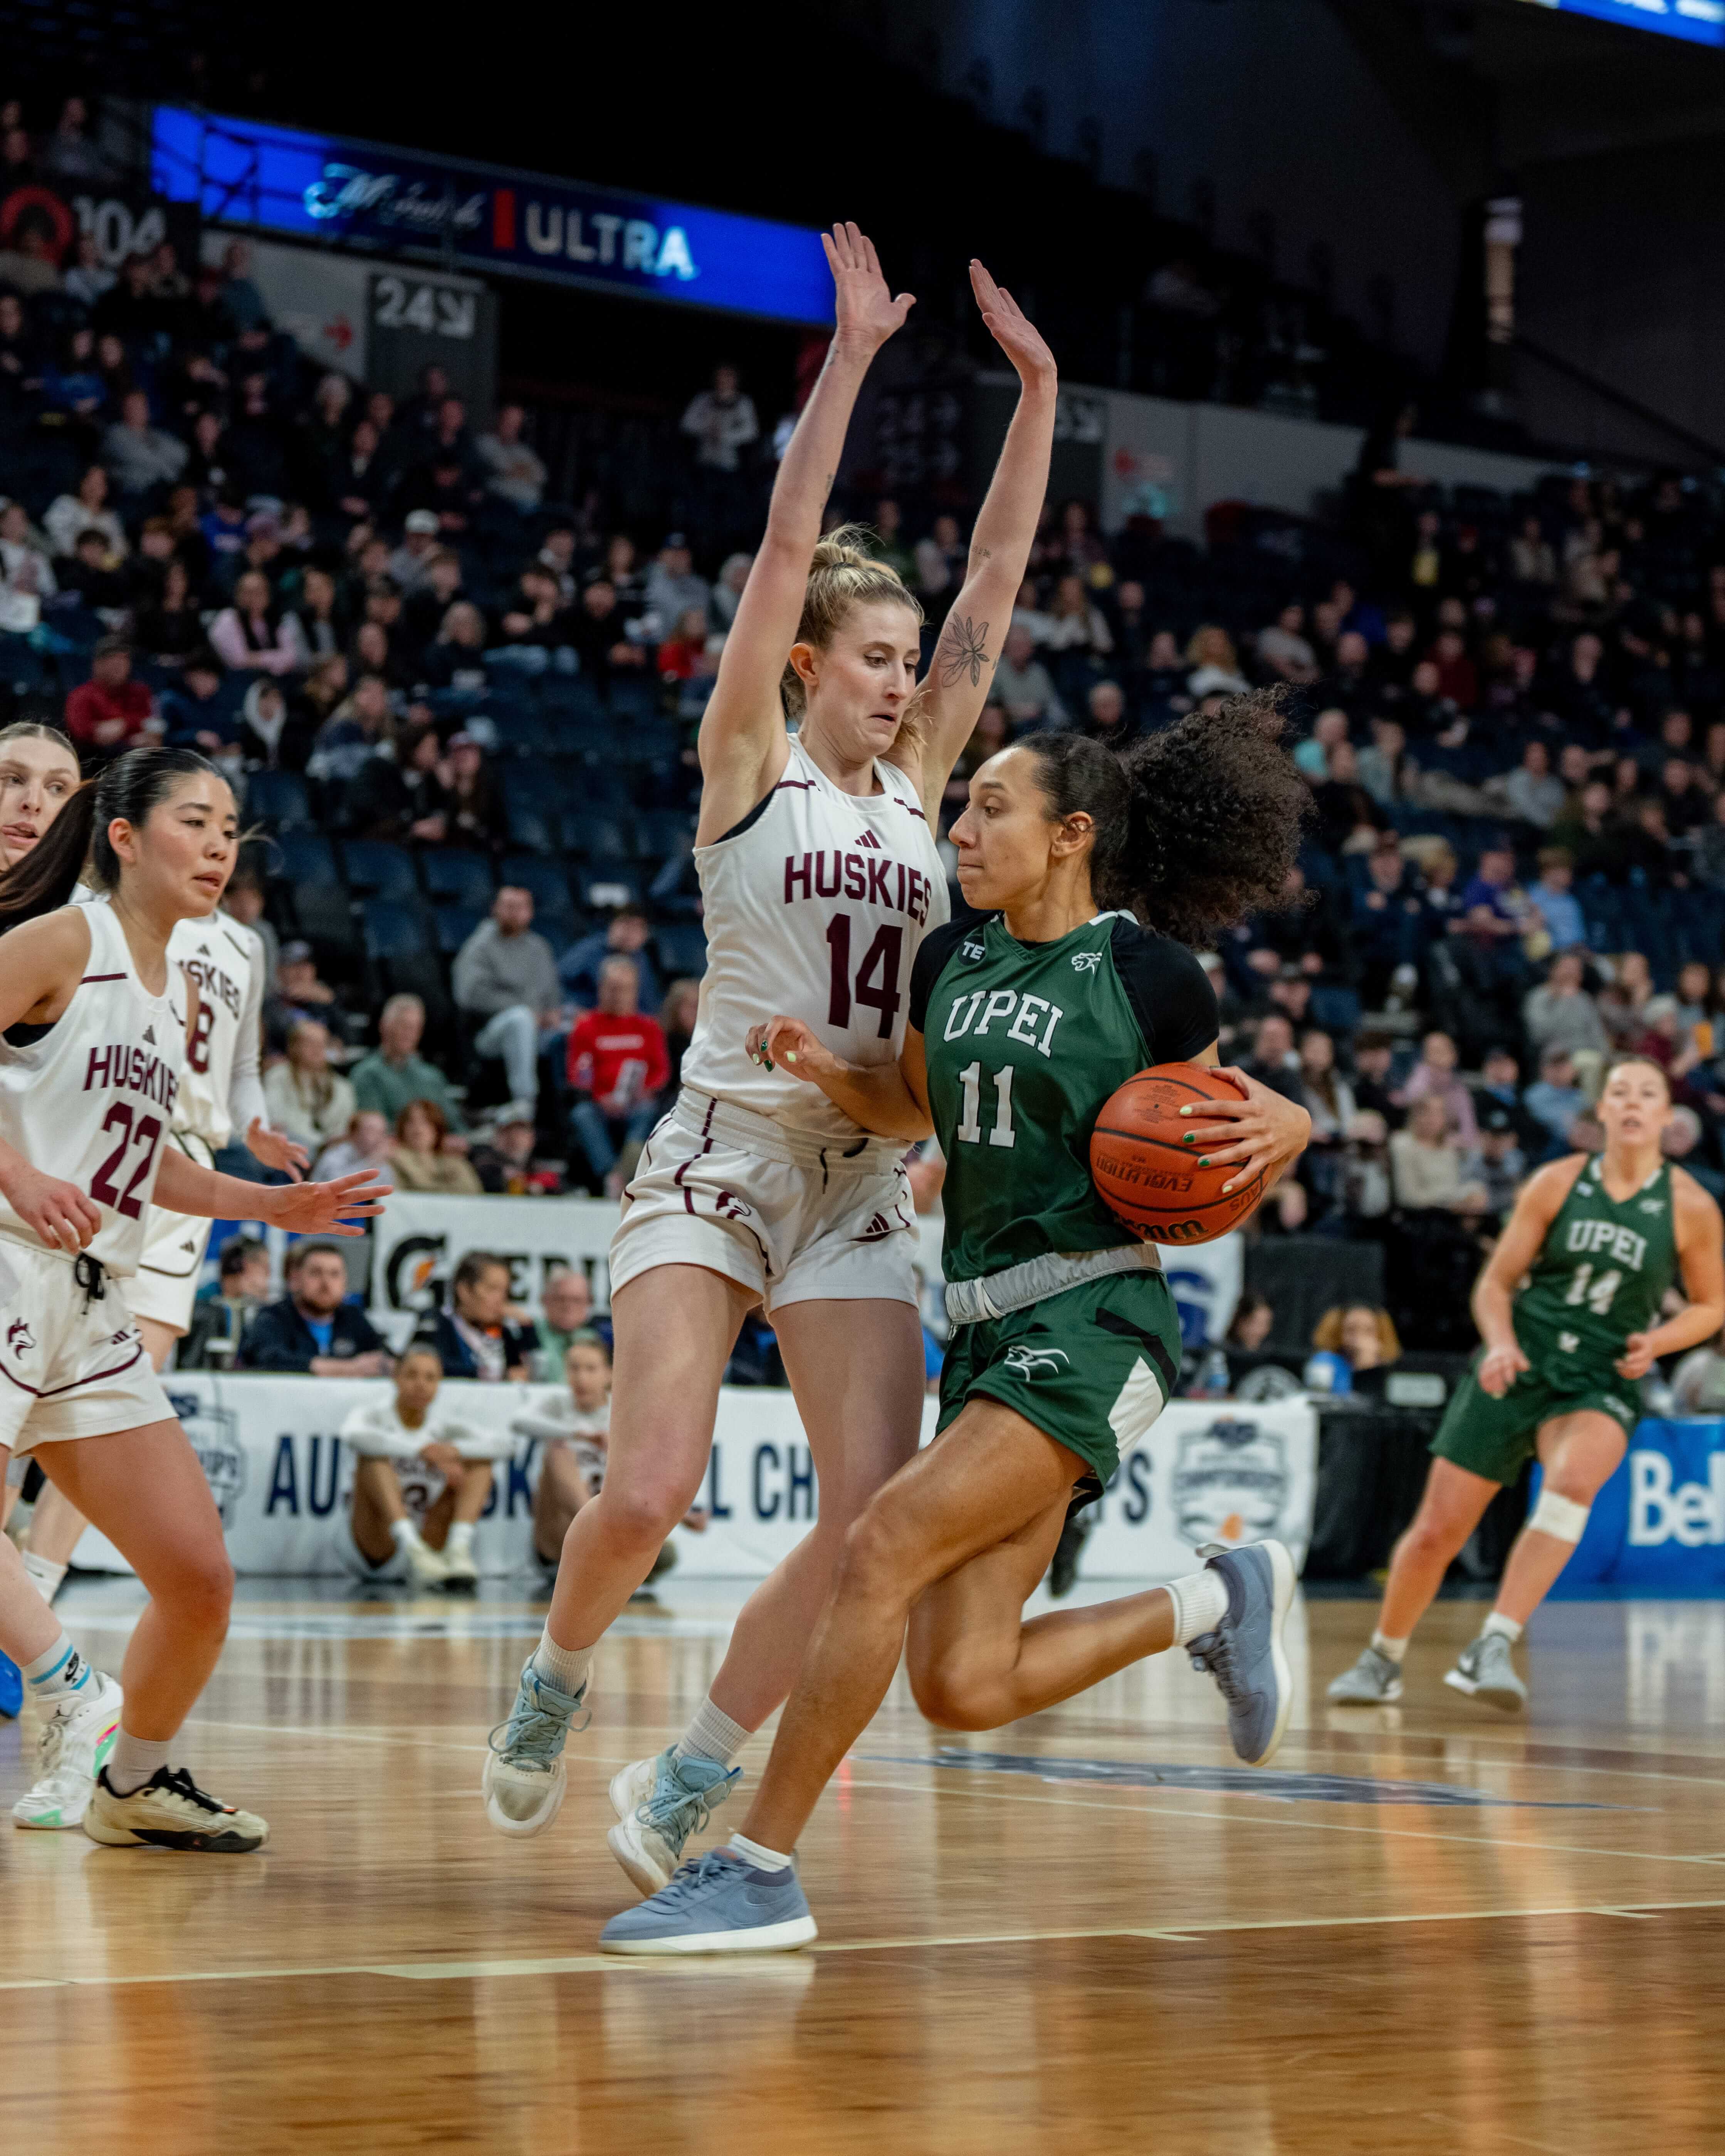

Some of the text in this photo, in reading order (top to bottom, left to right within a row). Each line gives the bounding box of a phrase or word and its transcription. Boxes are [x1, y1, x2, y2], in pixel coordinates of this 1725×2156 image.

[525, 201, 697, 280] ULTRA
[375, 275, 434, 334] 24
[784, 850, 932, 929] HUSKIES
[826, 913, 903, 1039] 14
[963, 940, 985, 960] TE
[179, 959, 240, 1021] SKIES
[943, 989, 1065, 1059] UPEI
[957, 1061, 1016, 1148] 11
[89, 1100, 163, 1221] 22
[1096, 1154, 1194, 1192] EVOLUTION
[1566, 1221, 1648, 1271] UPEI
[1564, 1263, 1623, 1316] 14
[266, 1435, 345, 1518] AU
